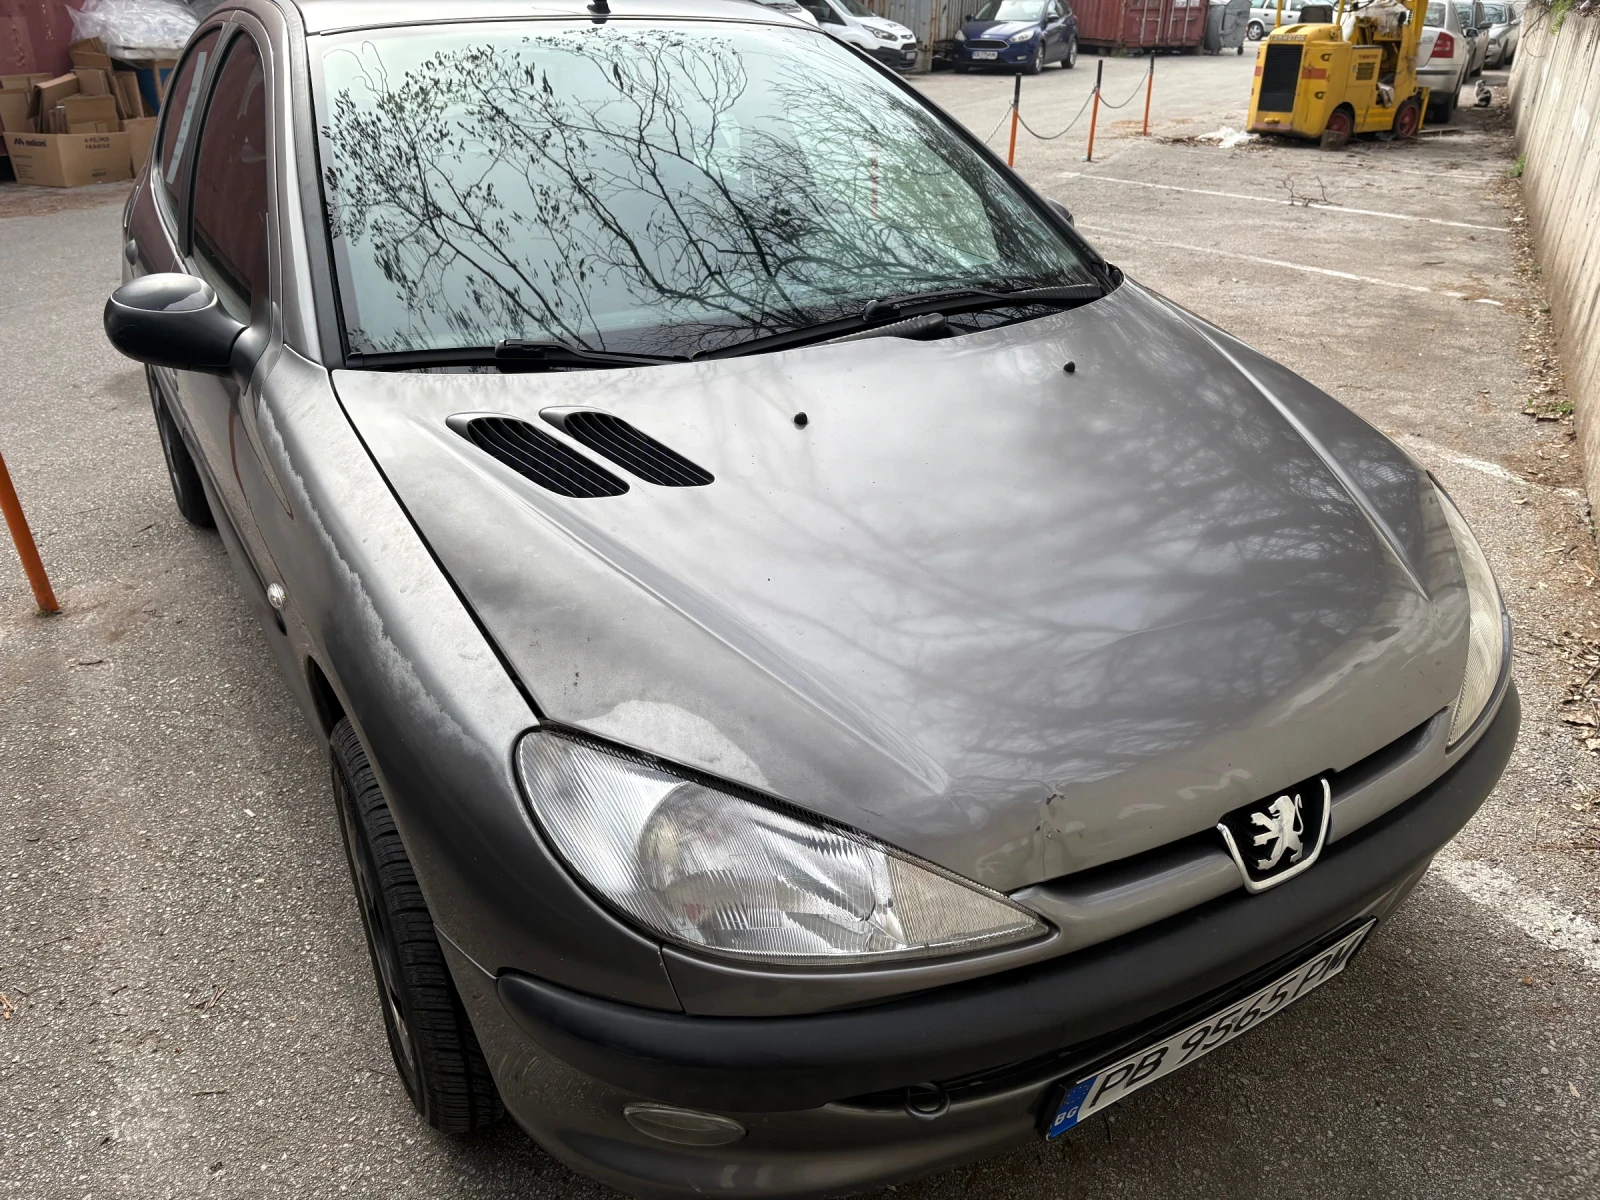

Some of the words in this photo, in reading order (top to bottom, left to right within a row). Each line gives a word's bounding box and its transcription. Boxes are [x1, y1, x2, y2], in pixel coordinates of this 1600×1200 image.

[1090, 1046, 1169, 1107] PB
[1175, 973, 1300, 1065] 9565
[1291, 933, 1362, 999] PM
[1054, 1107, 1077, 1126] BG
